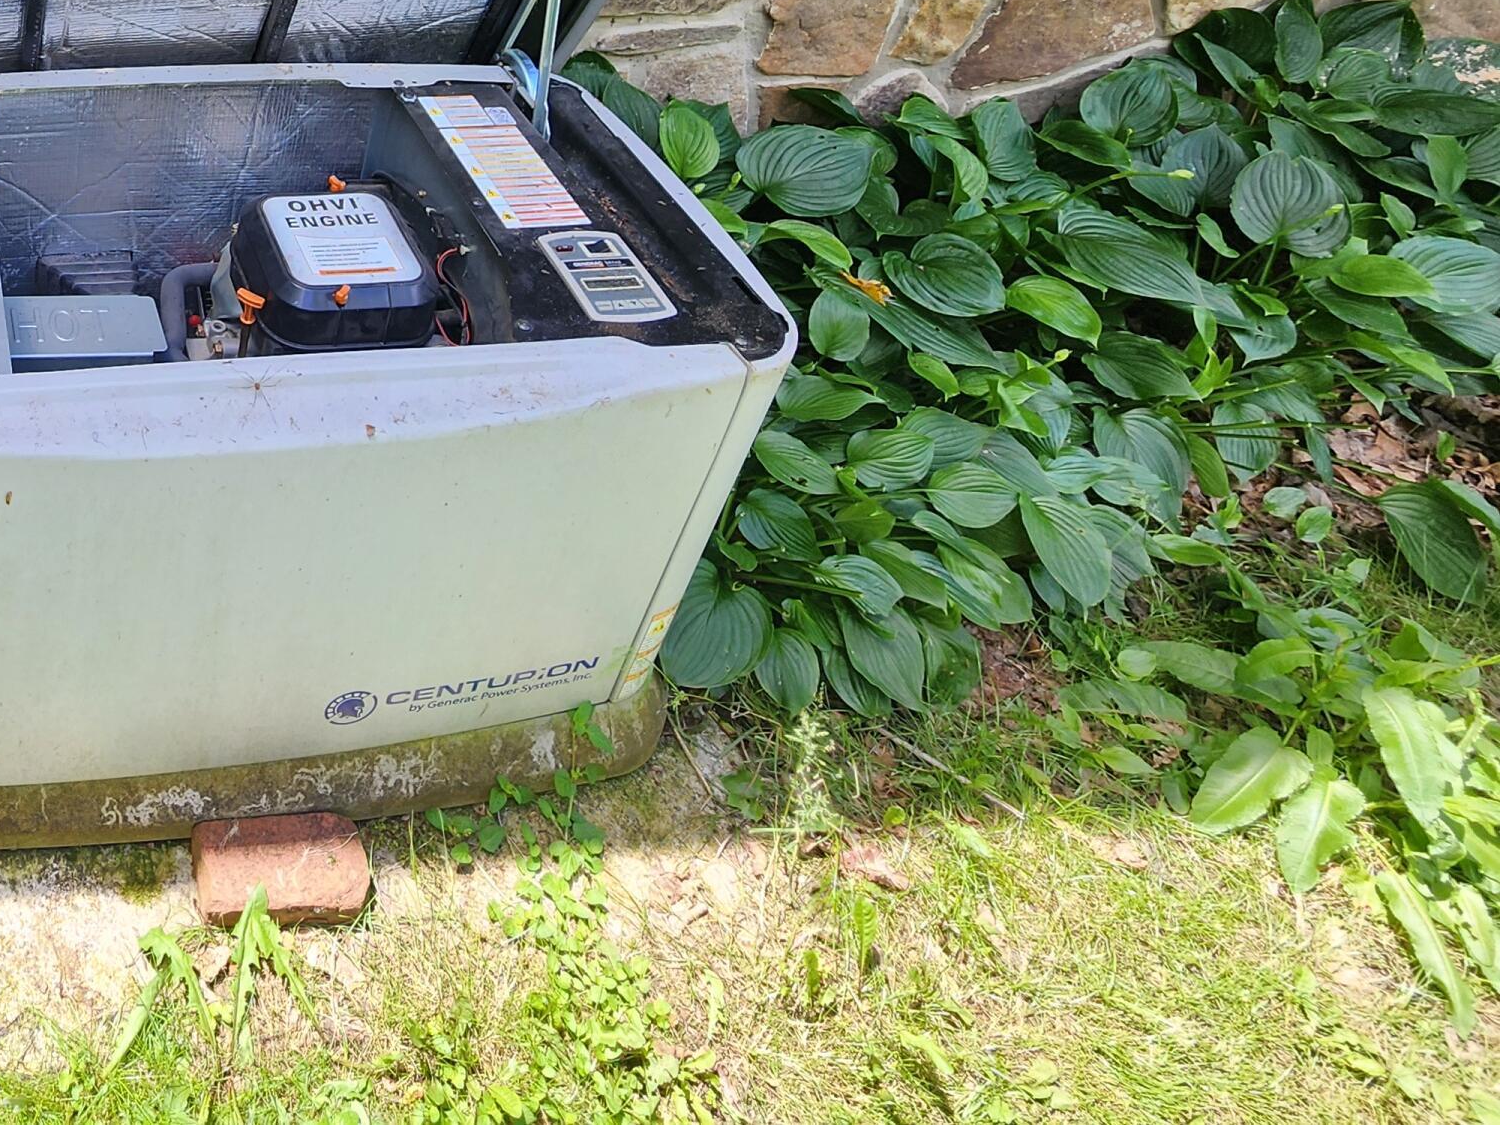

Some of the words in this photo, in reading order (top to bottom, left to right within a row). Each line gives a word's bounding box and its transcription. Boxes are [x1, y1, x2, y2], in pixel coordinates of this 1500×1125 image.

[287, 198, 358, 213] OHVI
[285, 213, 379, 228] ENGINE
[9, 306, 109, 344] HOT
[408, 703, 425, 713] by
[427, 694, 479, 709] Generac
[480, 686, 519, 700] Power
[572, 672, 593, 683] Inc.
